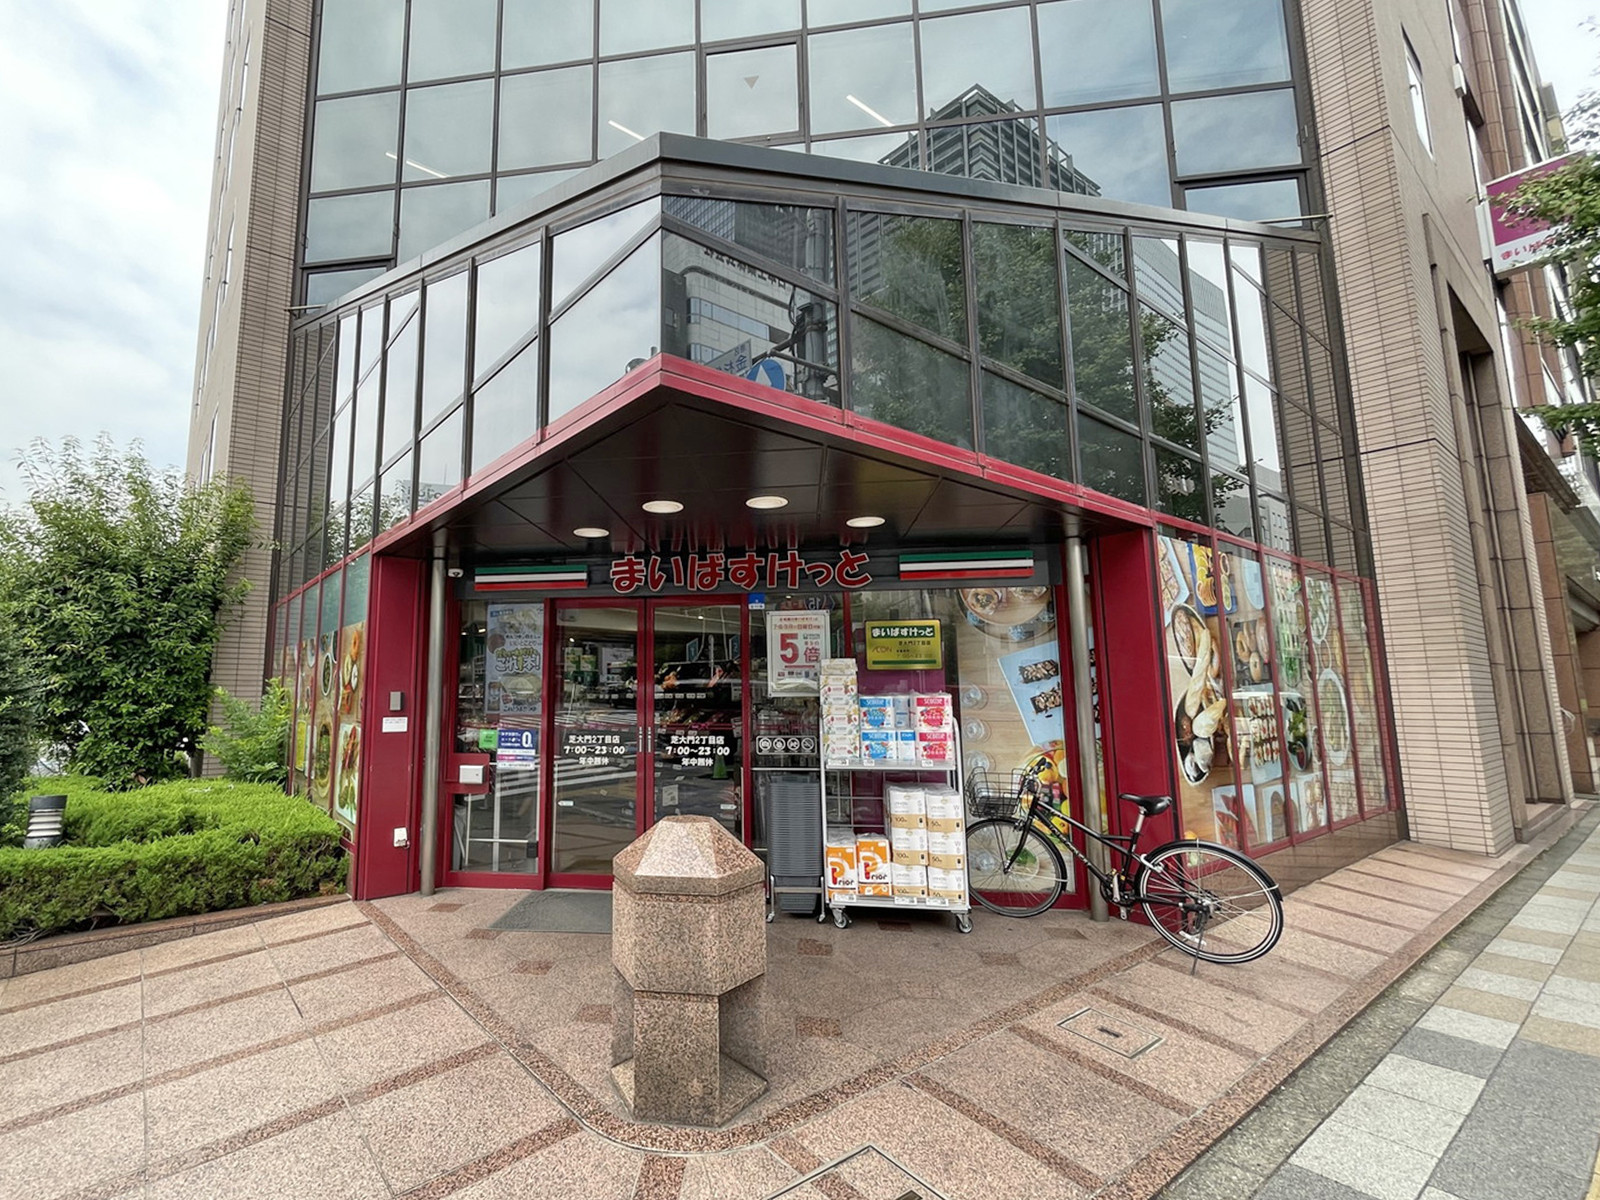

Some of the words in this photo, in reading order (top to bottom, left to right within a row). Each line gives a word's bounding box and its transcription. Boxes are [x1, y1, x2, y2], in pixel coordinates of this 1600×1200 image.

[610, 549, 872, 593] まいばすけっと
[872, 627, 934, 637] まいばすけっと
[780, 632, 799, 664] 5
[804, 647, 820, 663] 倍
[568, 735, 620, 744] 芝大門2丁目店
[670, 735, 725, 745] 芝大門2丁目店
[681, 756, 714, 767] 年中無休
